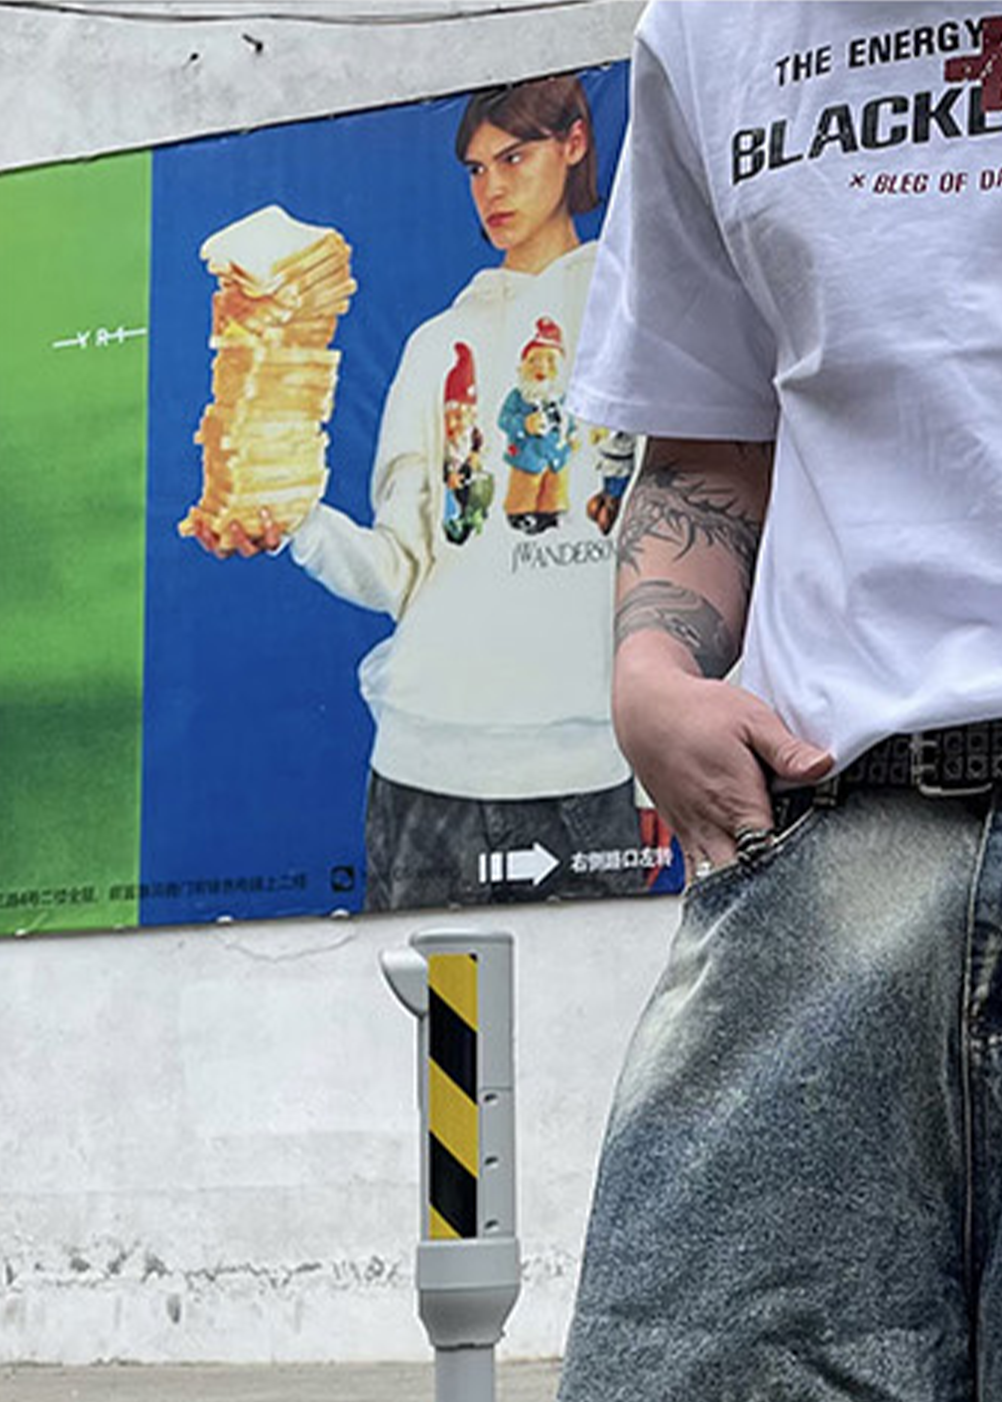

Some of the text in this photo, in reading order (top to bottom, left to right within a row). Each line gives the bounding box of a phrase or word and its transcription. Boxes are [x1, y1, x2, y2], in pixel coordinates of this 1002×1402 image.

[775, 47, 831, 87] THE
[848, 16, 984, 68] ENERGY
[938, 172, 968, 192] OF
